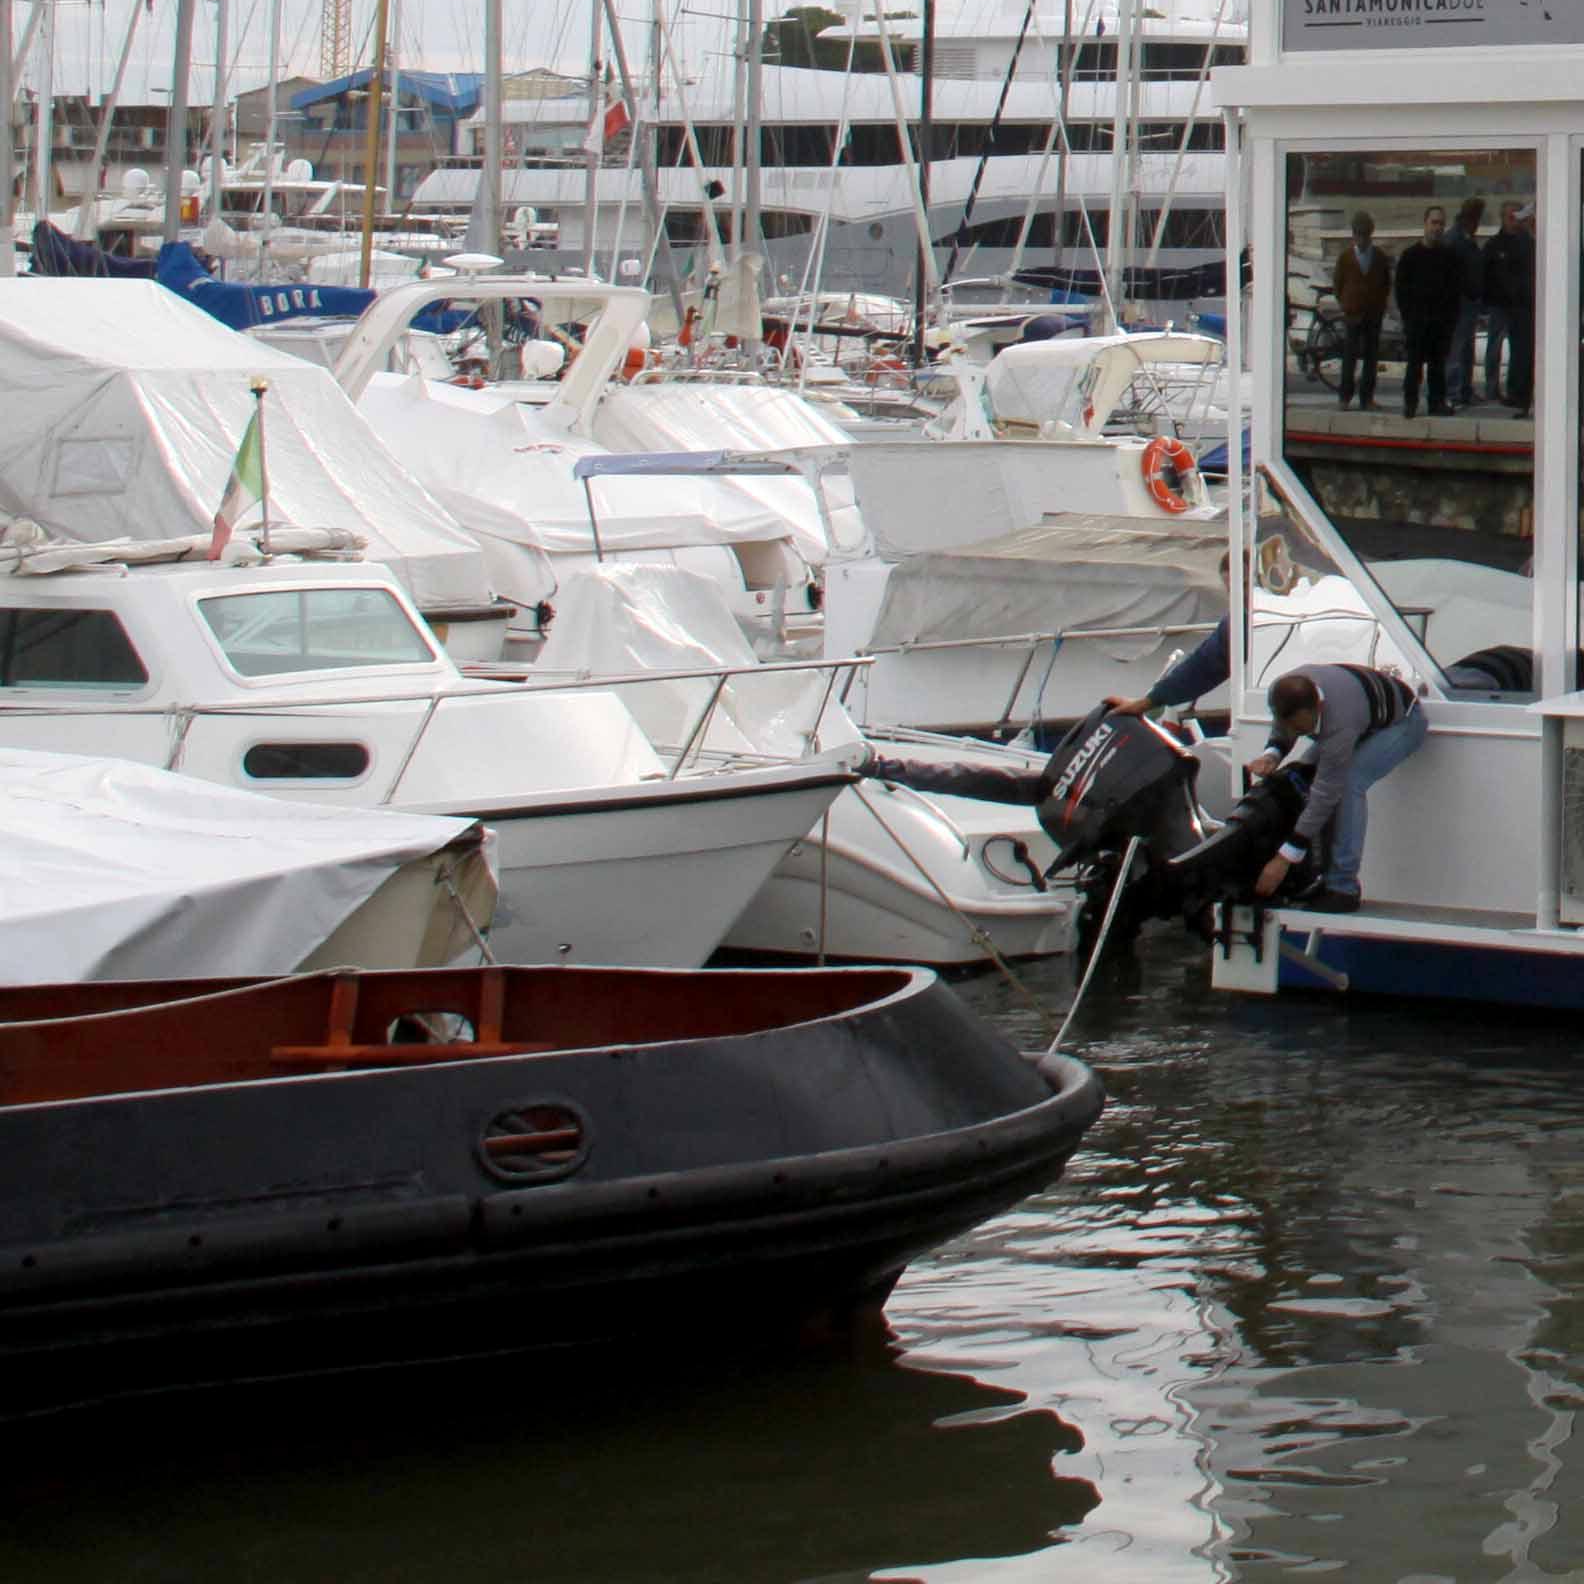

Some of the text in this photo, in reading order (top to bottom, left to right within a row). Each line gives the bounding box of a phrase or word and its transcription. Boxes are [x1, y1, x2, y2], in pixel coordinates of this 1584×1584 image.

[1365, 16, 1421, 27] VIAREGGIO
[260, 288, 322, 316] BORA
[1052, 722, 1113, 801] SUZUKI
